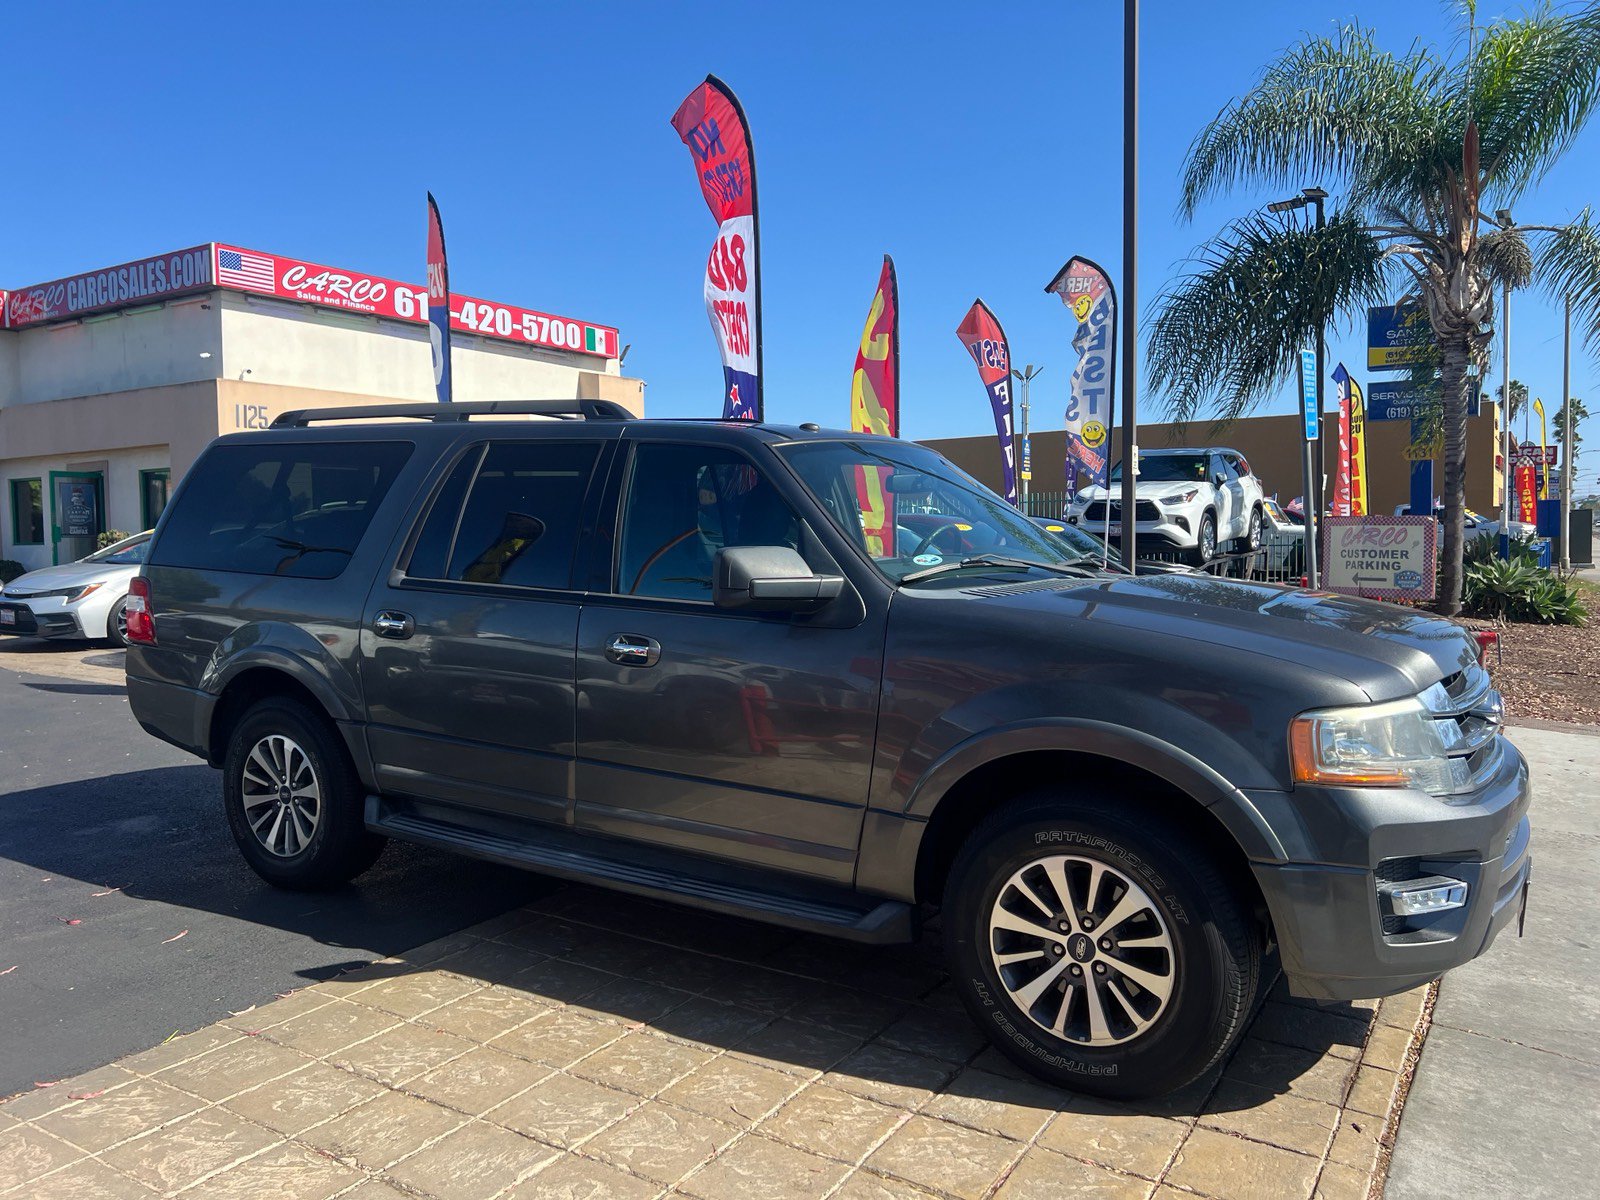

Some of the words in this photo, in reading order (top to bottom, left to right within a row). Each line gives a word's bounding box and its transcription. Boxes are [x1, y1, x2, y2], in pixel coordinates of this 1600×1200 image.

[10, 283, 65, 320] CARCO
[67, 249, 211, 312] CARCOSALES.COM
[281, 265, 387, 303] CARCO
[394, 286, 581, 349] 61-420-5700
[296, 290, 322, 302] Sales
[324, 297, 341, 305] and
[342, 299, 376, 311] Finance
[235, 404, 269, 430] 1125
[1341, 526, 1409, 548] CARCO
[1340, 549, 1410, 560] CUSTOMER
[1345, 560, 1402, 571] PARKING
[1035, 830, 1166, 890] PATHFINDER
[1164, 895, 1190, 925] HT
[992, 1010, 1118, 1077] PATHFINDER
